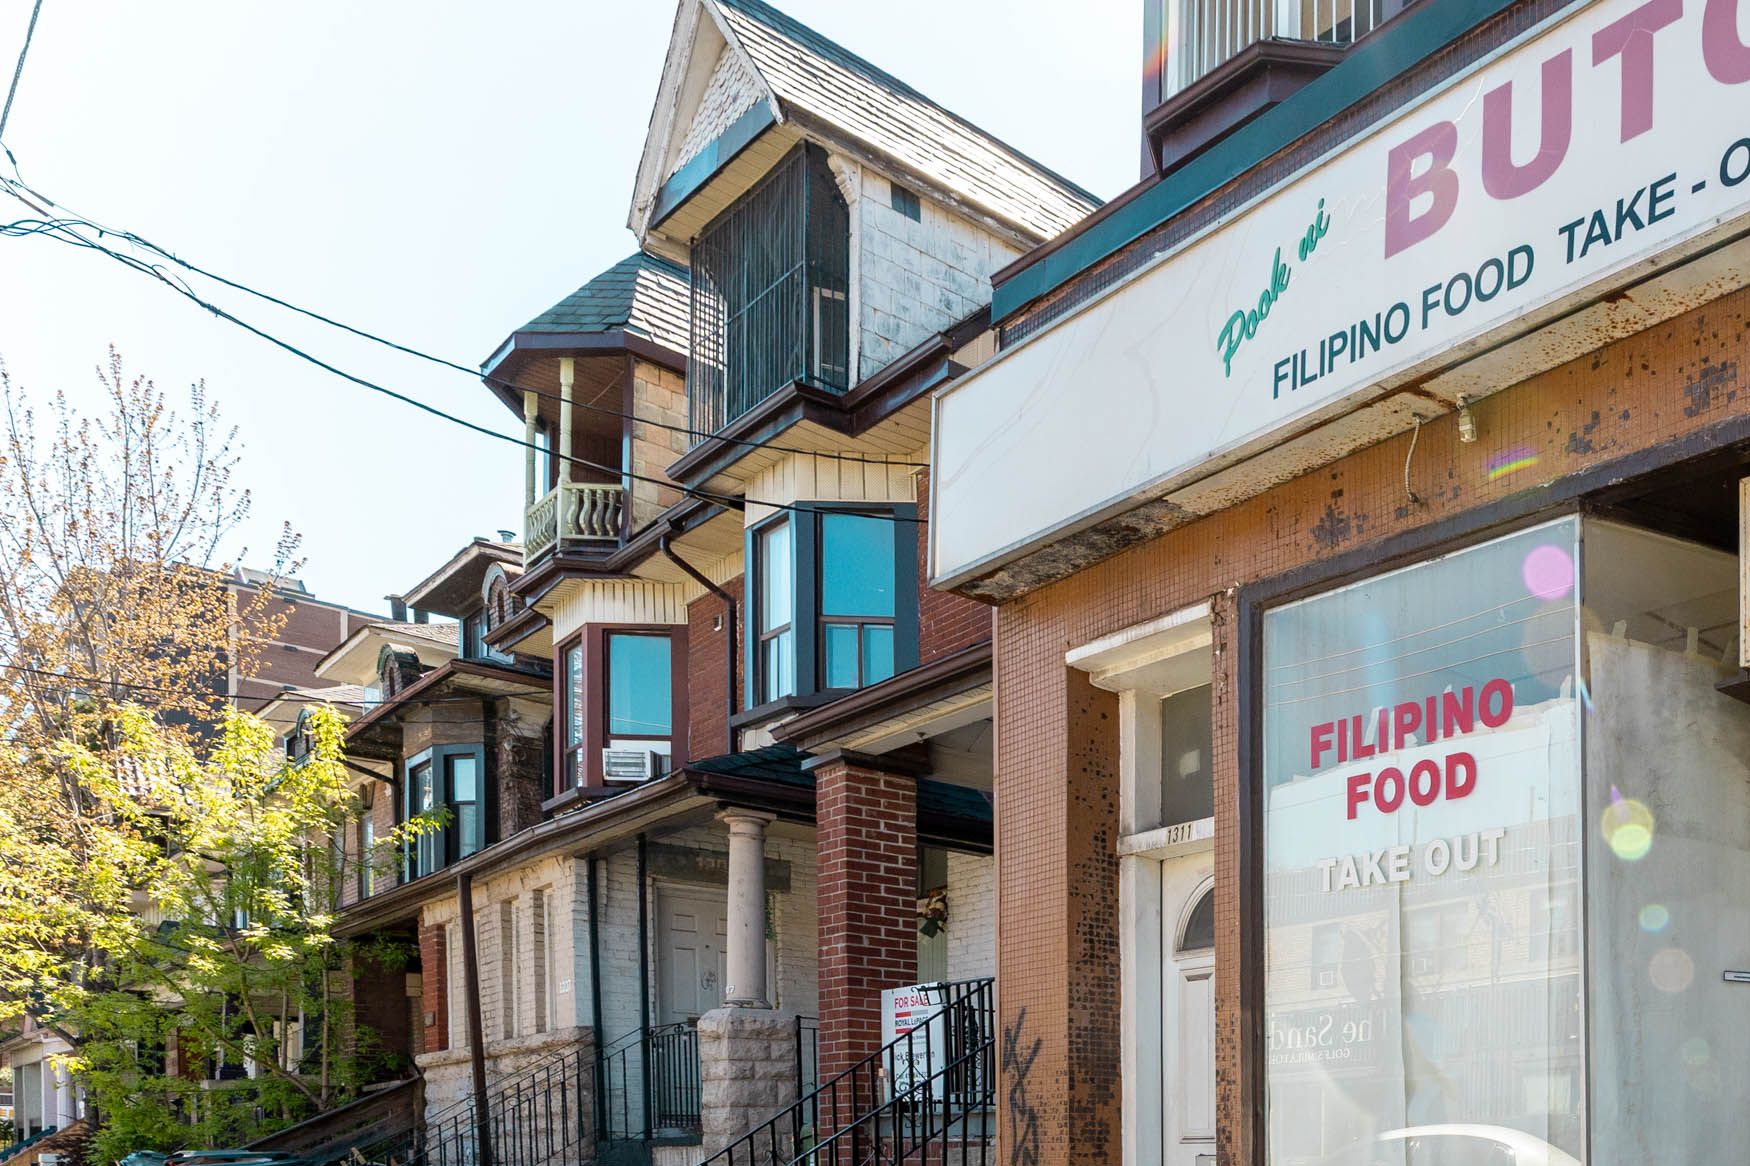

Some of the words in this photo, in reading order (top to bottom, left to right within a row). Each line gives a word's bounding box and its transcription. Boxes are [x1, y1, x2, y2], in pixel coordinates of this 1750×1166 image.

[1217, 246, 1292, 378] Pook
[1299, 198, 1331, 261] ni
[1273, 302, 1411, 399] FILIPINO
[1422, 244, 1535, 329] FOOD
[1558, 172, 1676, 264] TAKE
[1310, 678, 1515, 769] FILIPINO
[1347, 752, 1478, 820] FOOD
[1167, 823, 1193, 845] 1311
[1317, 844, 1411, 892] TAKE
[1424, 827, 1505, 876] OUT
[895, 996, 909, 1008] FOR
